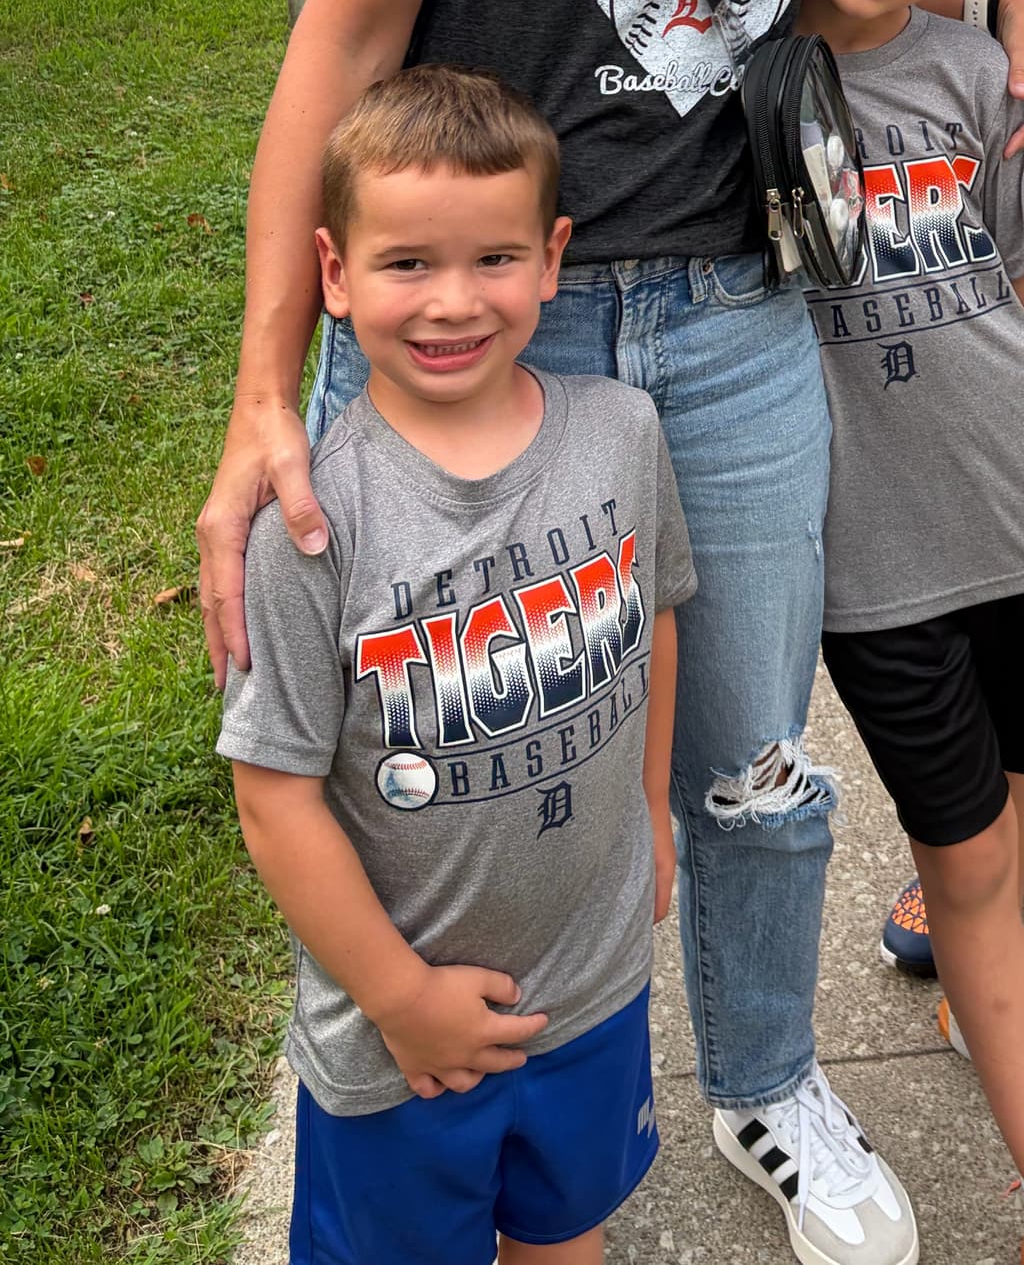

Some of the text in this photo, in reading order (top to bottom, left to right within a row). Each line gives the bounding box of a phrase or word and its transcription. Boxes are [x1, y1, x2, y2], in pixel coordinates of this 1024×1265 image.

[595, 60, 712, 95] Baseball
[390, 499, 618, 621] DETROIT
[354, 526, 647, 750] TIGERS
[447, 661, 649, 797] BASEBALL
